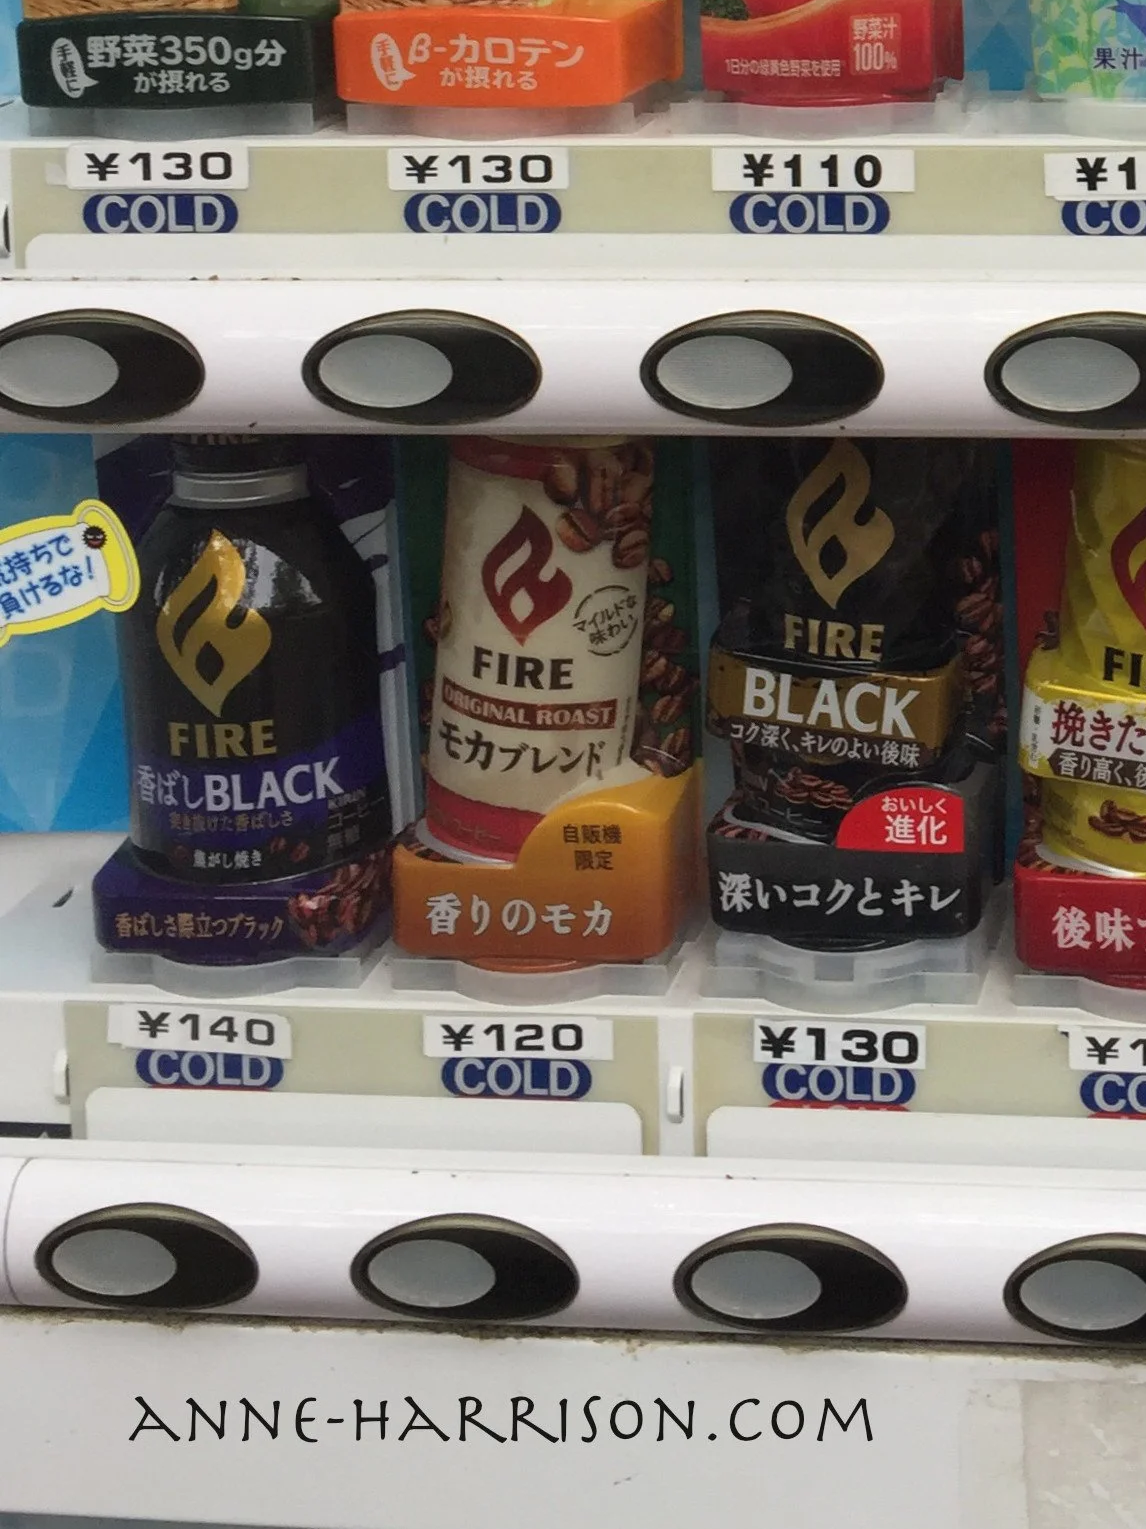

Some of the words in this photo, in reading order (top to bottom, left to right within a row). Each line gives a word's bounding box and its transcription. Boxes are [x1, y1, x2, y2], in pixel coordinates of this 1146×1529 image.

[853, 17, 897, 41] 野菜汁
[86, 34, 287, 70] 野菜350g分
[853, 42, 898, 72] 100%
[133, 71, 231, 94] が摂れる
[440, 68, 539, 90] が摂れる
[86, 152, 232, 182] ¥130
[404, 154, 553, 184] ¥130
[743, 153, 883, 189] ¥110
[96, 194, 226, 234] COLD
[417, 193, 548, 233] COLD
[743, 193, 878, 234] COLD
[0, 555, 95, 620] 負けるな！
[783, 614, 885, 663] FIRE
[472, 645, 574, 690] FIRE
[444, 681, 531, 724] ORIGINAL
[536, 706, 614, 726] ROAST
[742, 667, 923, 739] BLACK
[168, 718, 279, 758] FIRE
[438, 720, 606, 778] モカブレンド
[730, 722, 922, 769] コク深く、キレのよい後味
[881, 796, 948, 815] おいしく
[562, 824, 622, 845] 自販機
[884, 815, 948, 847] 進化
[574, 850, 615, 871] 限定
[718, 871, 962, 918] 深いコクとキレ
[426, 892, 613, 938] 香りのモカ
[138, 1010, 276, 1046] ¥140
[441, 1023, 584, 1052] ¥120
[759, 1026, 920, 1064] ¥130
[148, 1049, 273, 1087] COLD
[454, 1058, 581, 1098] COLD
[775, 1065, 903, 1102] COLD
